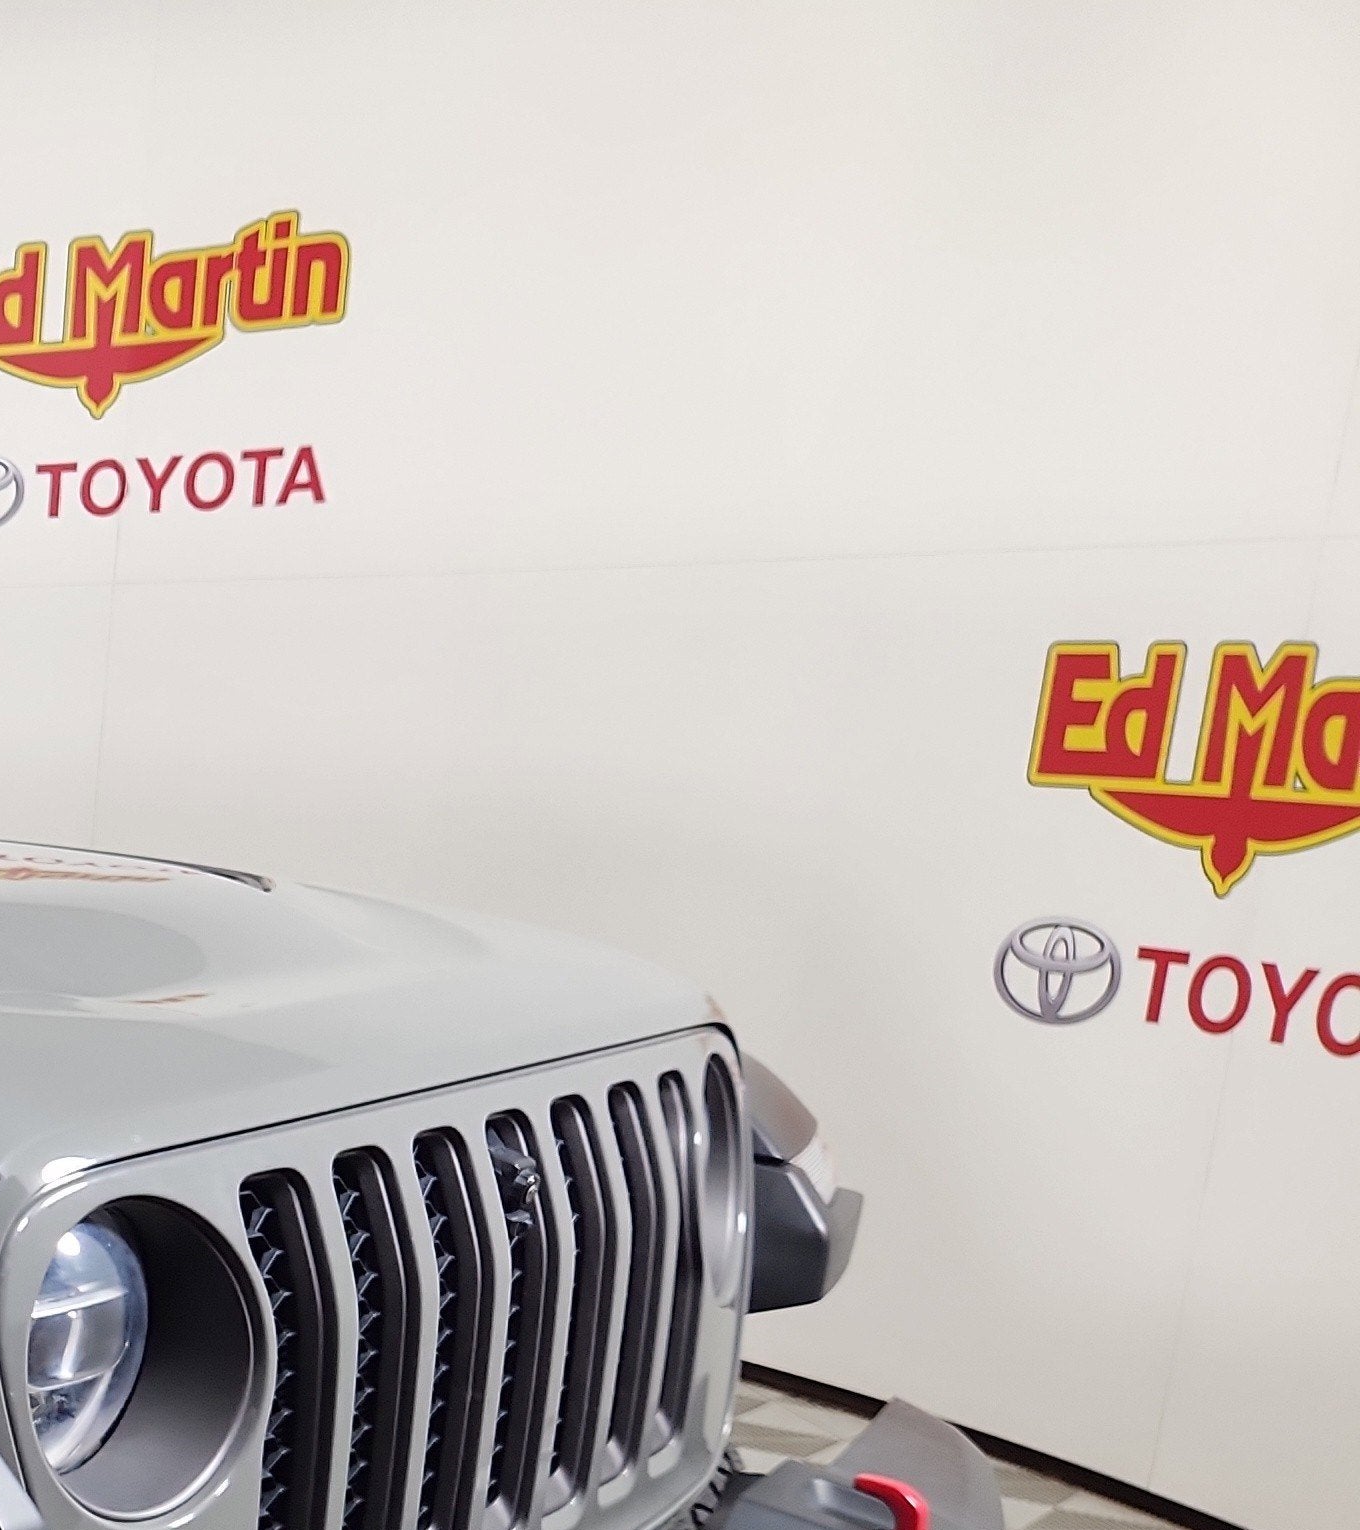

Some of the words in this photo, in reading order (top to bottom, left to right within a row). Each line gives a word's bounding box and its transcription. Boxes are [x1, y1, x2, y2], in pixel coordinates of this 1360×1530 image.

[66, 217, 348, 341] Martin
[36, 445, 326, 520] TOYOTA
[1036, 651, 1179, 782] Ed
